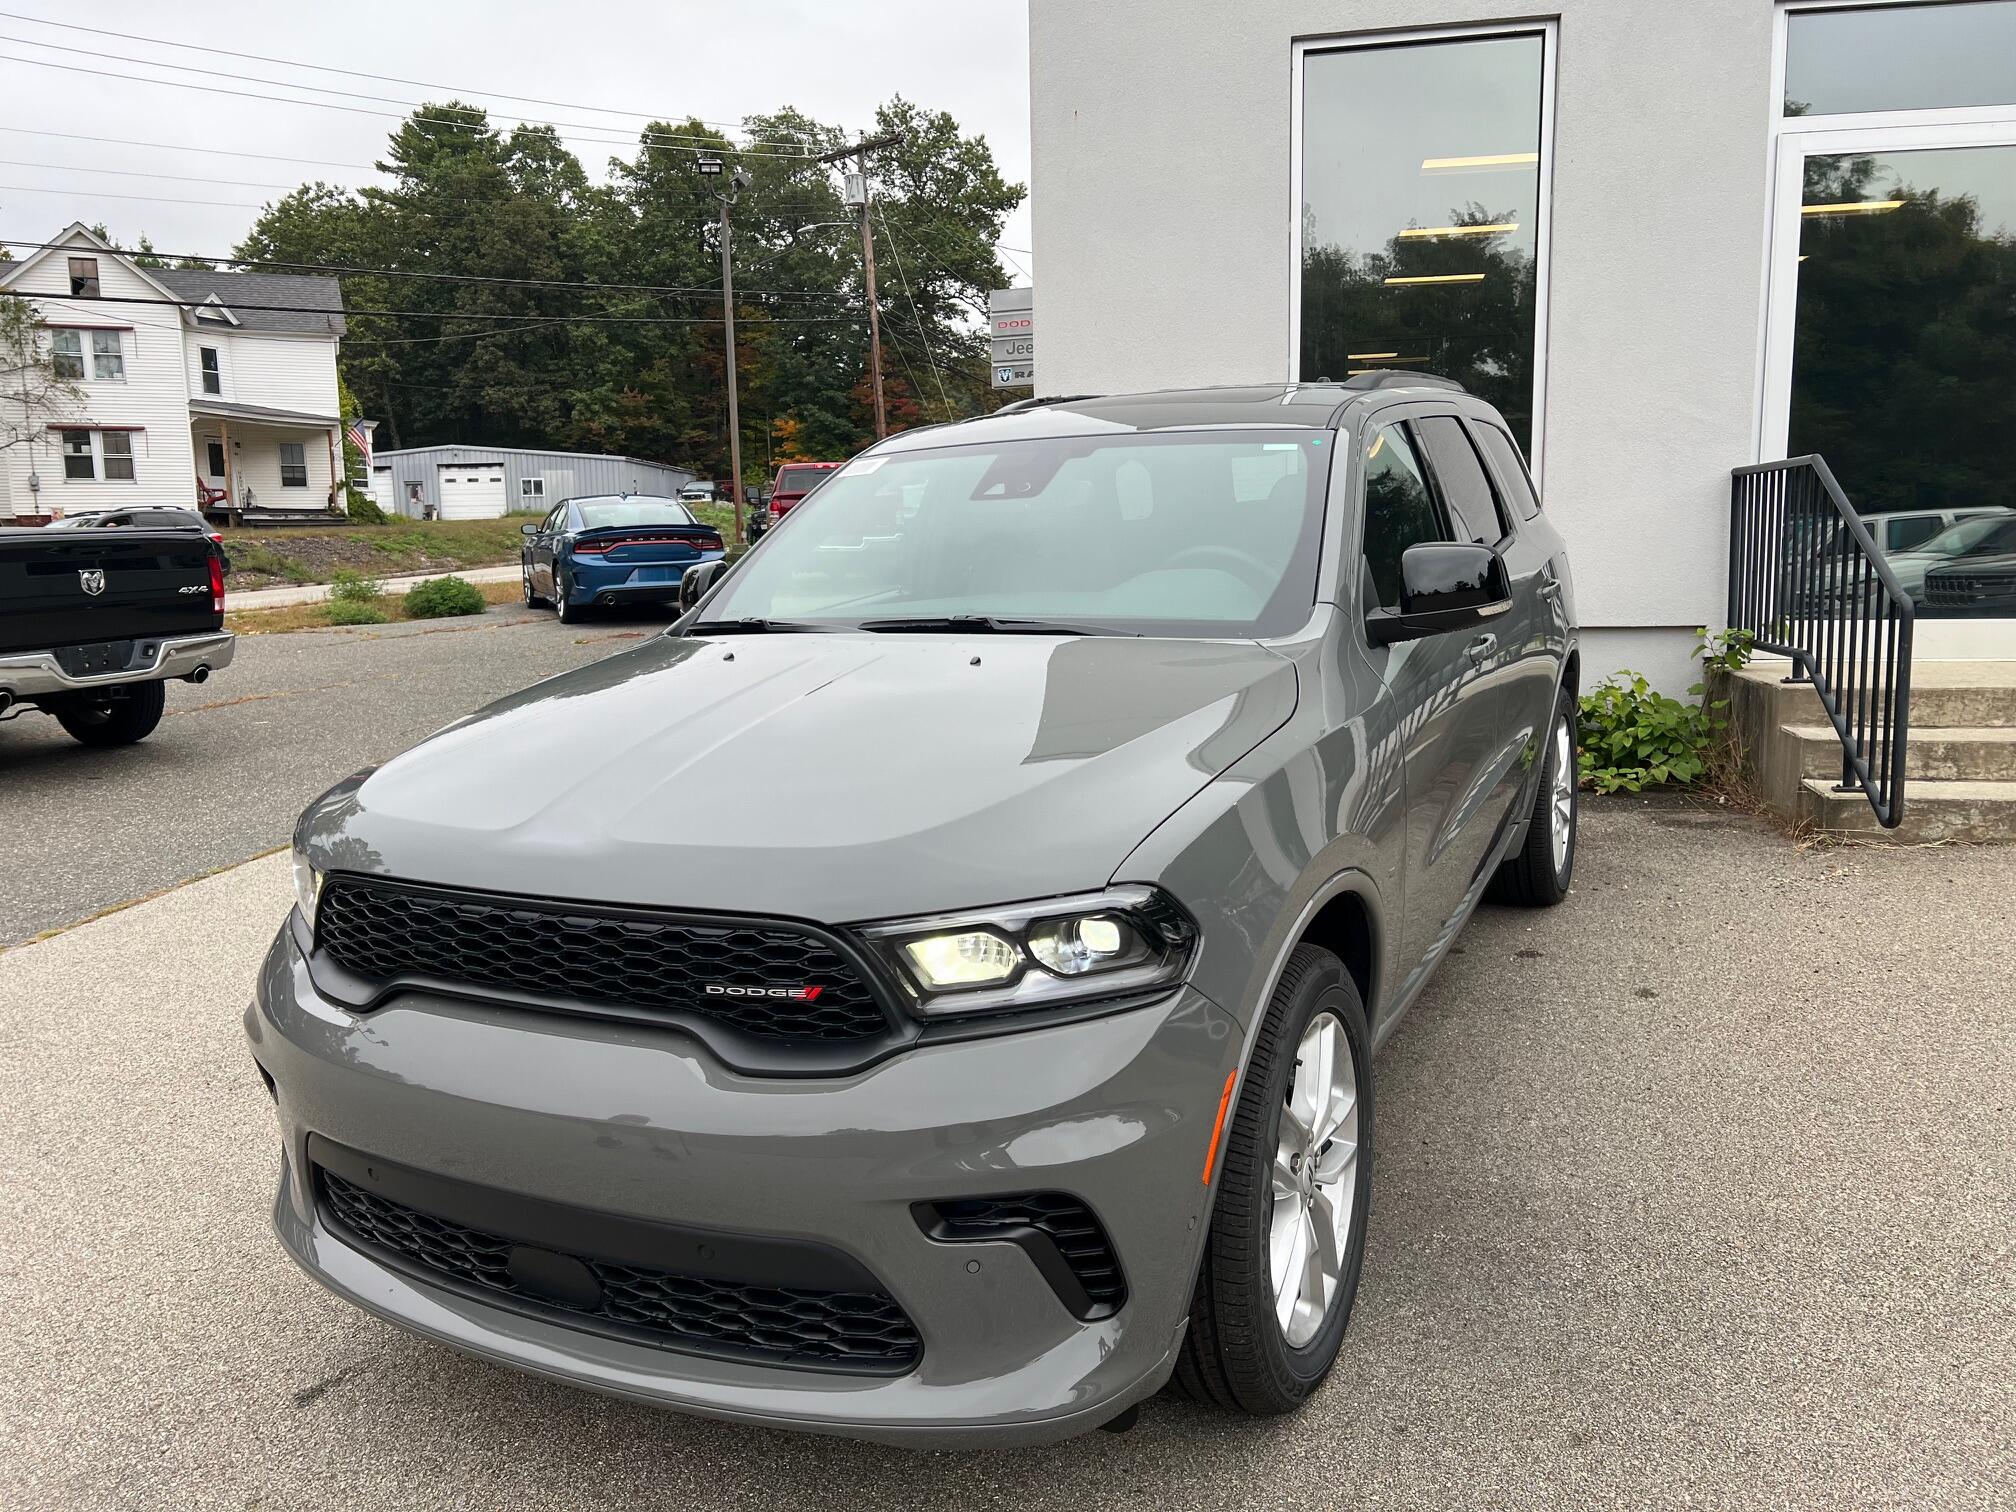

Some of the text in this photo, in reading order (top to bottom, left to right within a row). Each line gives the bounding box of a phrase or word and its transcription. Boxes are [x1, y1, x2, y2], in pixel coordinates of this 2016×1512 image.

[998, 320, 1032, 329] DOD
[1006, 341, 1033, 355] Jee
[1014, 370, 1033, 379] RA
[705, 985, 808, 998] DODGE
